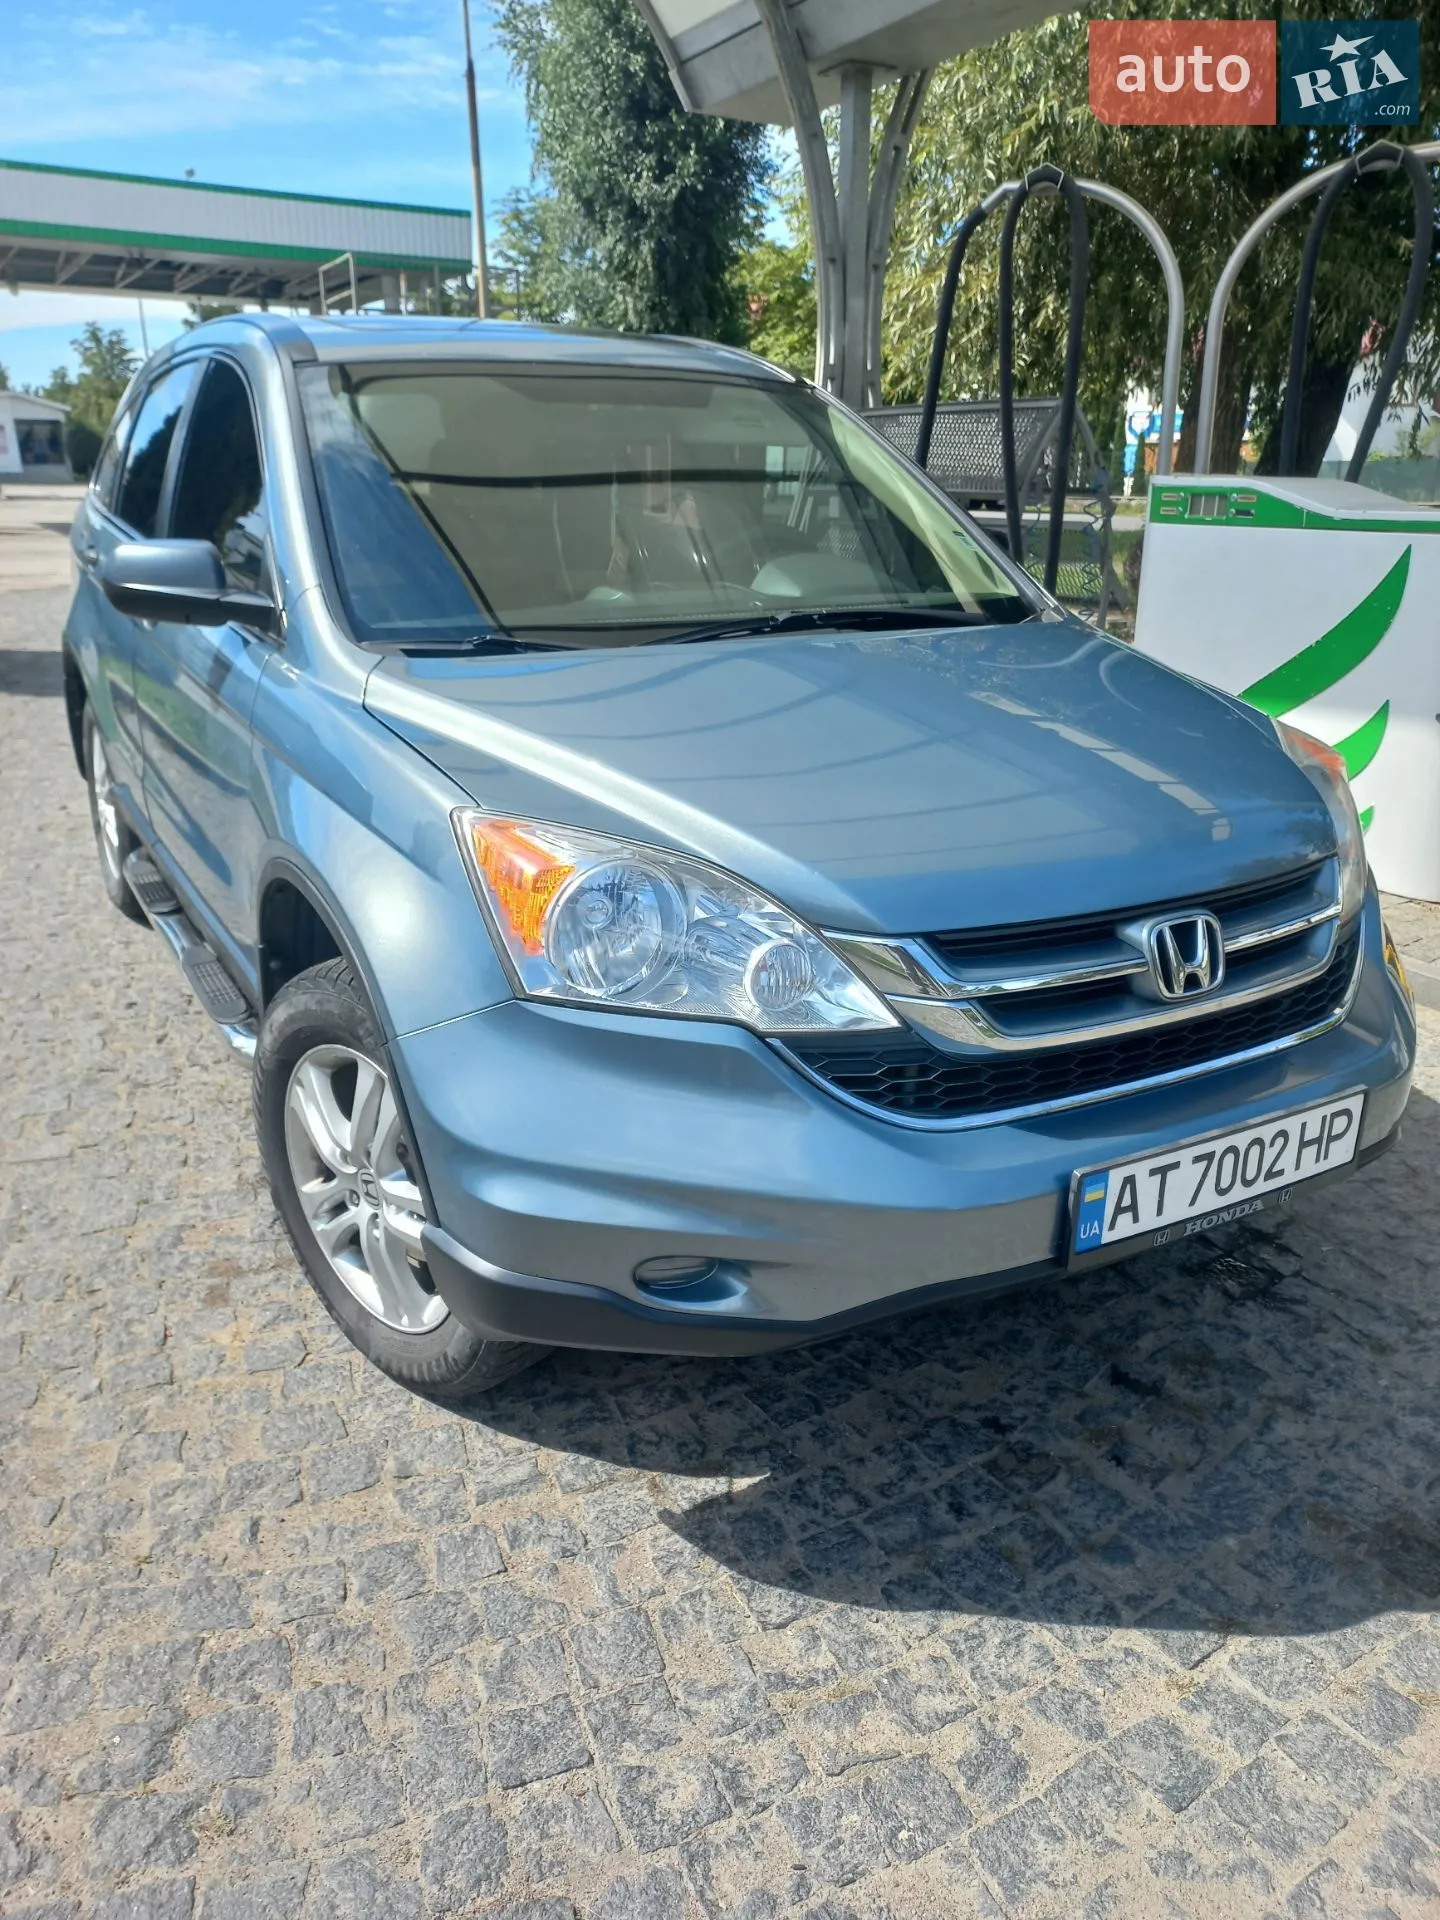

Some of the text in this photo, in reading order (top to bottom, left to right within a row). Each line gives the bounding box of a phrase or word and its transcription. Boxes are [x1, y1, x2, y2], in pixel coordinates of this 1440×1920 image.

[1107, 1107, 1353, 1232] AT 7002 HP
[1080, 1220, 1100, 1239] UA
[1183, 1199, 1265, 1237] HONDA
